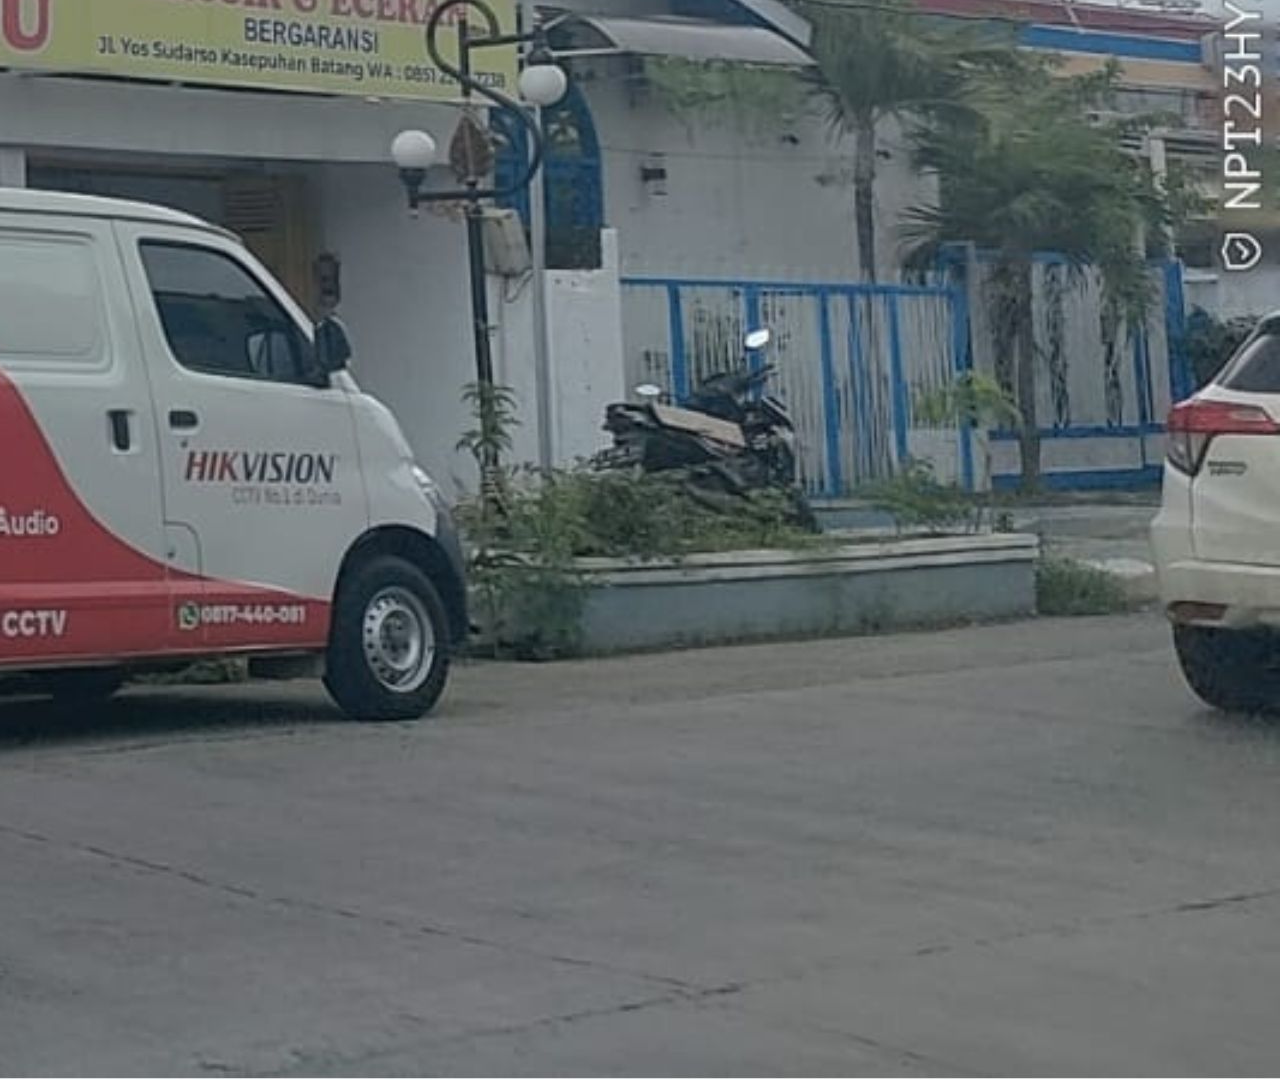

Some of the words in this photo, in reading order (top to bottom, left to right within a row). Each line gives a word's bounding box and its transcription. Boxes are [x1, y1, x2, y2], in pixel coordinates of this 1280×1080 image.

[244, 18, 379, 54] BERGARANSI
[121, 38, 149, 57] Yos
[153, 41, 217, 65] Sudarso
[221, 48, 307, 74] Kasepuhan
[311, 57, 364, 81] Batang
[185, 451, 335, 483] HIKVISION
[2, 610, 66, 636] CCTV
